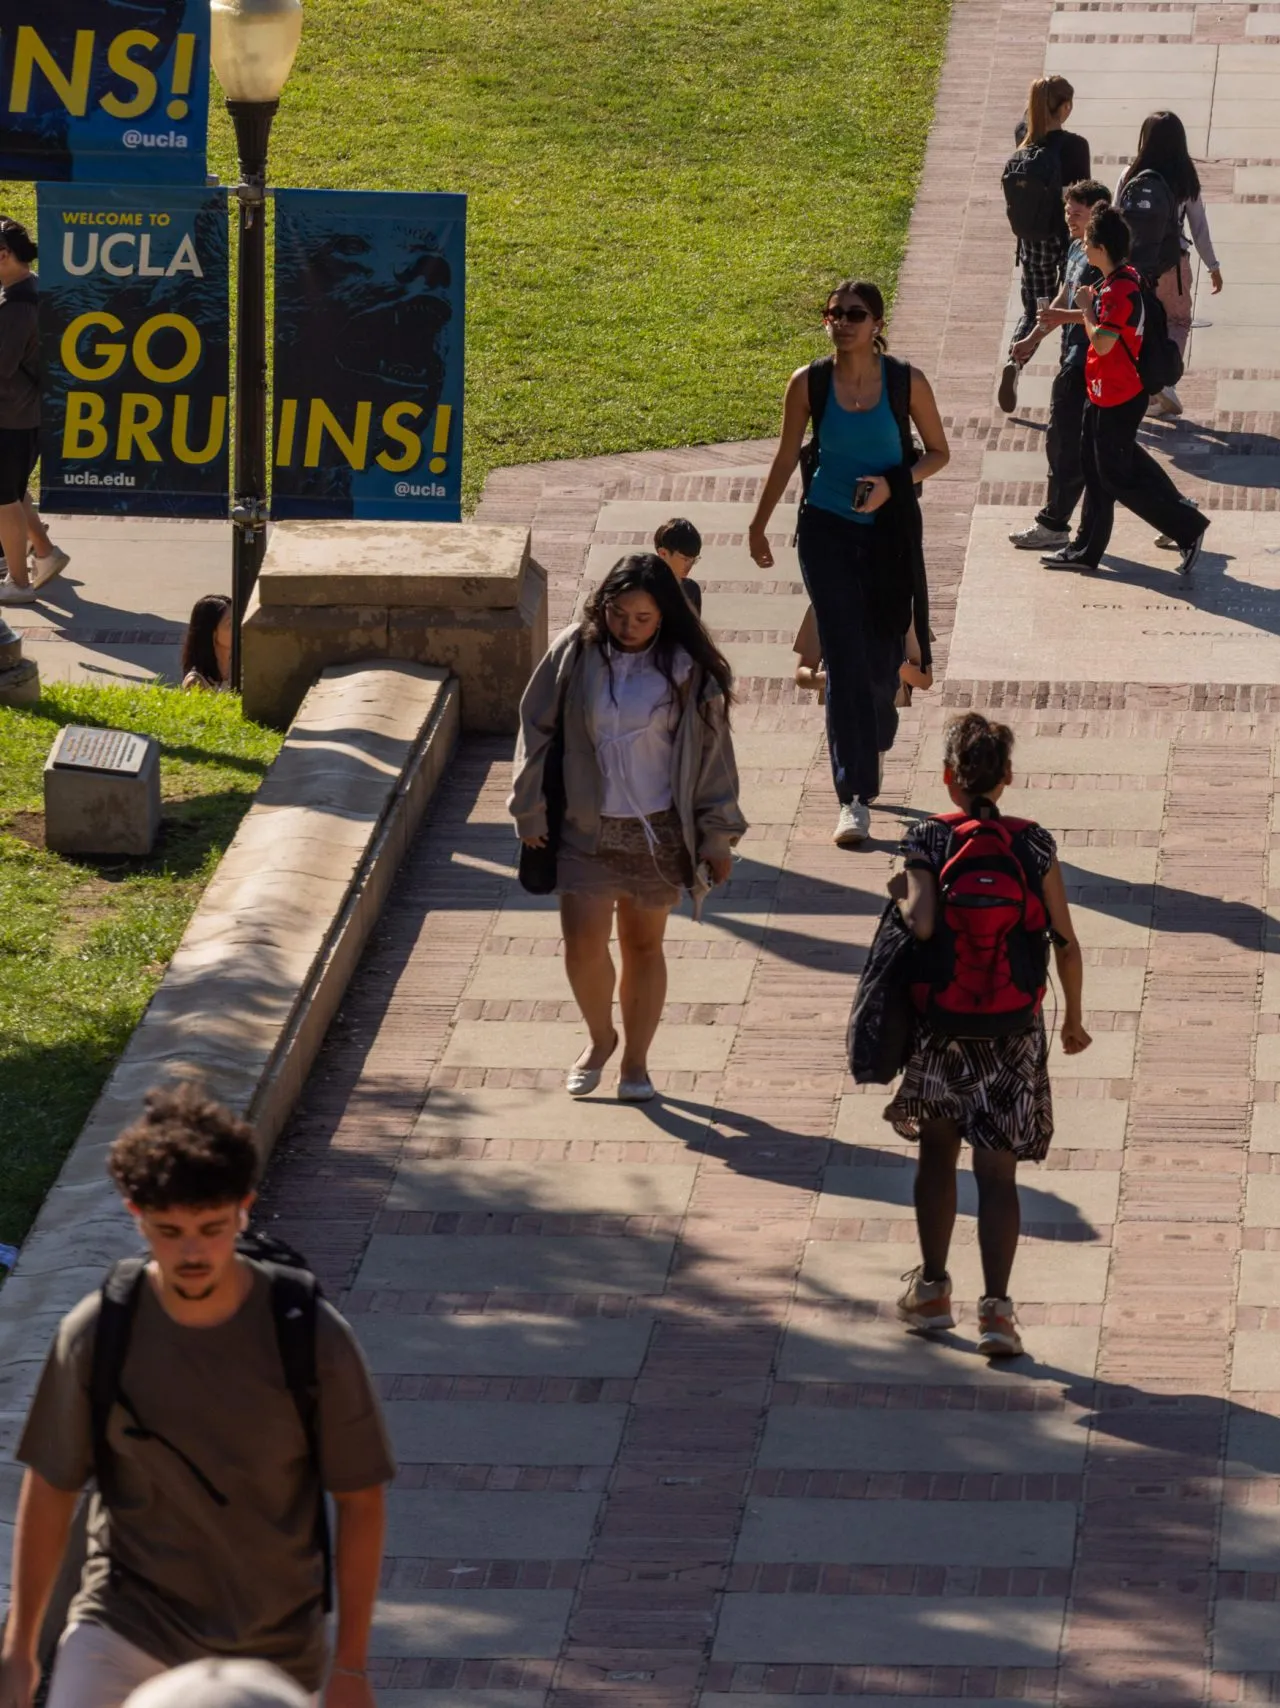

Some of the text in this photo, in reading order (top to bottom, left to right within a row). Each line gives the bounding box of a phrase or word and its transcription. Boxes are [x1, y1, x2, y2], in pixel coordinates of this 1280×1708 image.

[7, 25, 197, 120] NS!
[122, 130, 188, 148] @ucla
[62, 212, 172, 227] WELCOME TO
[62, 232, 204, 278] UCLA
[60, 311, 202, 384] GO
[62, 391, 227, 464] BRU
[275, 398, 452, 474] INS!
[64, 471, 136, 486] ucla.edu
[394, 481, 446, 497] @ucla
